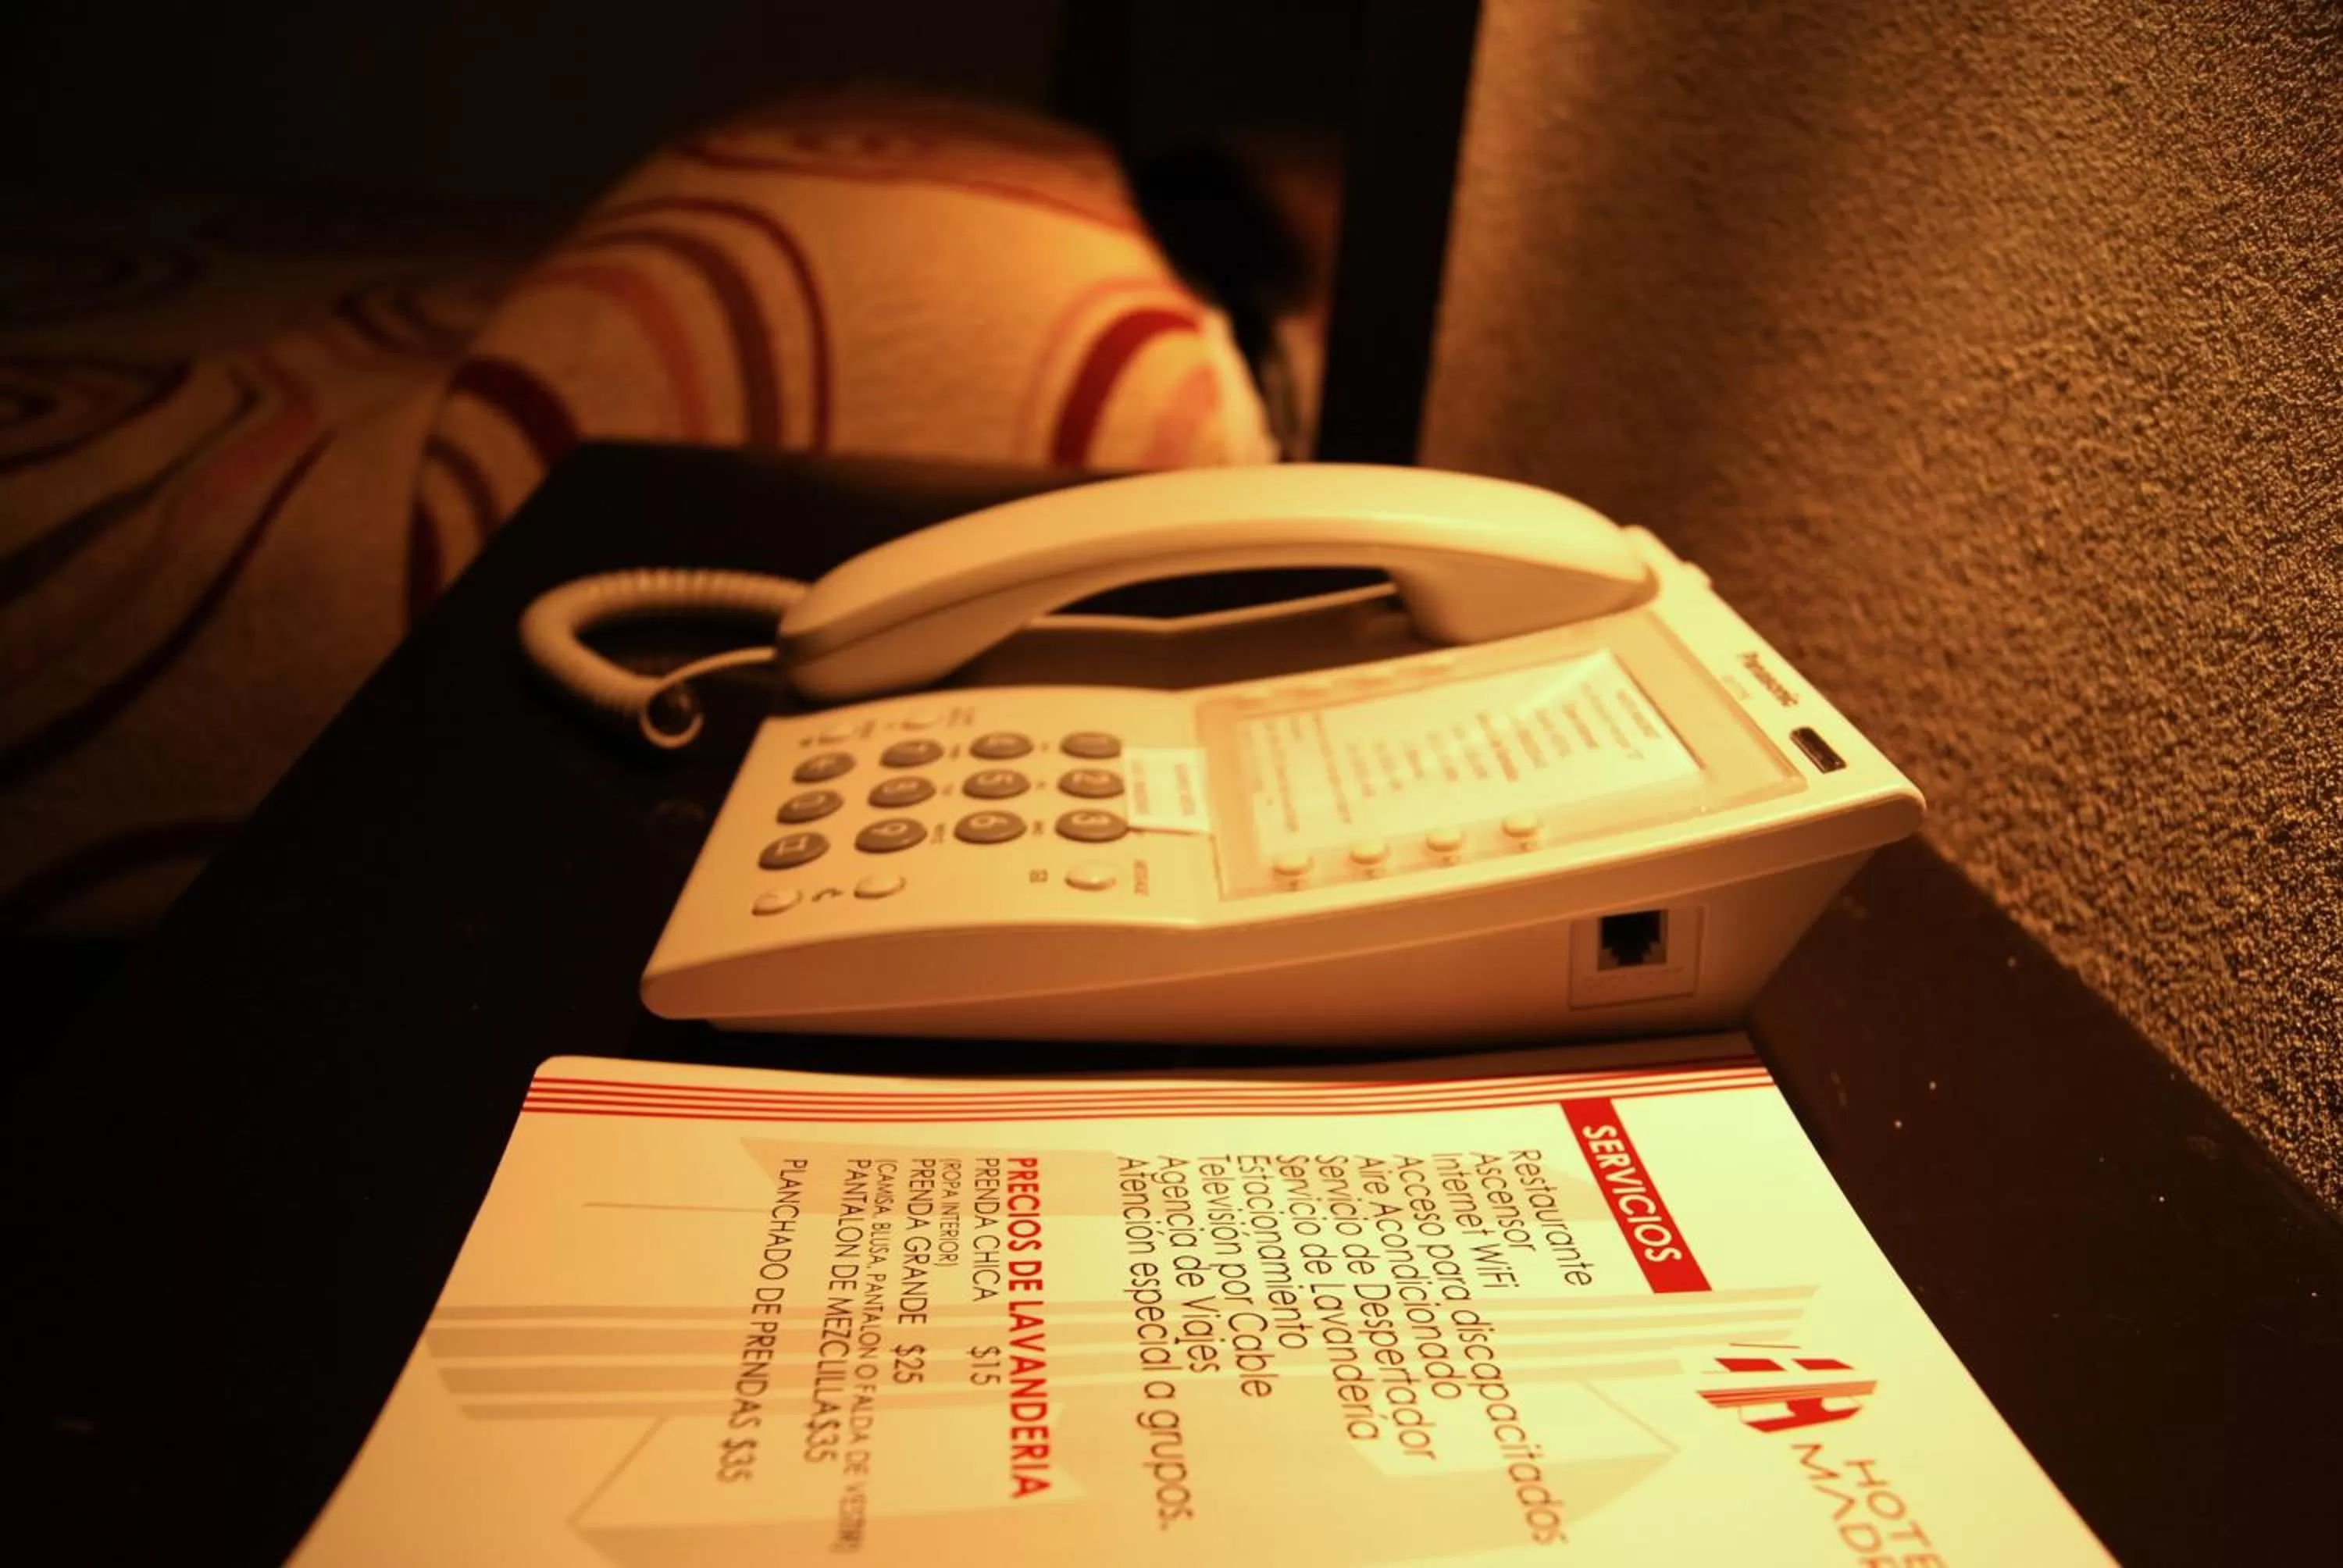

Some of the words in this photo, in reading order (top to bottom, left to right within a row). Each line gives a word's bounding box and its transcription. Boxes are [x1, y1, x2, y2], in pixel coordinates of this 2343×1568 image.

[835, 1159, 872, 1258] PANTALON
[905, 1158, 936, 1231] PRENDA
[939, 1160, 961, 1201] (ROPA
[974, 1158, 1000, 1230] PRENDA
[1007, 1157, 1043, 1252] PRECIOS
[1117, 1156, 1165, 1265] Atención
[1151, 1155, 1203, 1248] Agencia
[1197, 1153, 1247, 1255] Televisión
[1276, 1153, 1324, 1237] Servicio
[1314, 1153, 1363, 1237] Servicio
[1353, 1155, 1391, 1196] Aire
[1392, 1153, 1446, 1237] Acceso
[1469, 1152, 1537, 1253] Ascensor
[1582, 1124, 1682, 1263] SERVICIOS
[759, 1158, 808, 1281] PLANCHADO
[933, 1203, 961, 1267] INTERIOR)
[1236, 1155, 1314, 1349] Estacionamiento
[1432, 1153, 1487, 1235] Internet
[1472, 1245, 1520, 1288] WiFi
[1508, 1149, 1594, 1287] Restaurante
[752, 1286, 785, 1316] DE
[829, 1264, 859, 1291] DE
[897, 1235, 931, 1325] GRANDE
[972, 1235, 1000, 1303] CHICA
[1007, 1260, 1043, 1292] DE
[1173, 1255, 1212, 1288] de
[1216, 1262, 1254, 1306] por
[1299, 1245, 1336, 1277] de
[1340, 1245, 1377, 1278] de
[1369, 1203, 1468, 1401] Acondicionado
[1417, 1243, 1472, 1302] para
[858, 1272, 887, 1360] PANTALON
[1125, 1260, 1182, 1371] especial
[1174, 1295, 1226, 1374] Viajes
[1226, 1310, 1279, 1399] Cable
[727, 1320, 779, 1430] PRENDAS
[856, 1364, 878, 1380] O
[890, 1343, 925, 1385] $25
[968, 1345, 1001, 1386] $15
[1007, 1300, 1053, 1499] LAVANDERIA
[1143, 1381, 1176, 1400] a
[1310, 1283, 1389, 1442] Lavandería
[1353, 1284, 1436, 1461] Despertador
[847, 1384, 876, 1445] FALDA
[1450, 1309, 1568, 1546] discapacitados
[715, 1437, 758, 1485] $35
[843, 1449, 872, 1477] DE
[1136, 1409, 1193, 1531] grupos.
